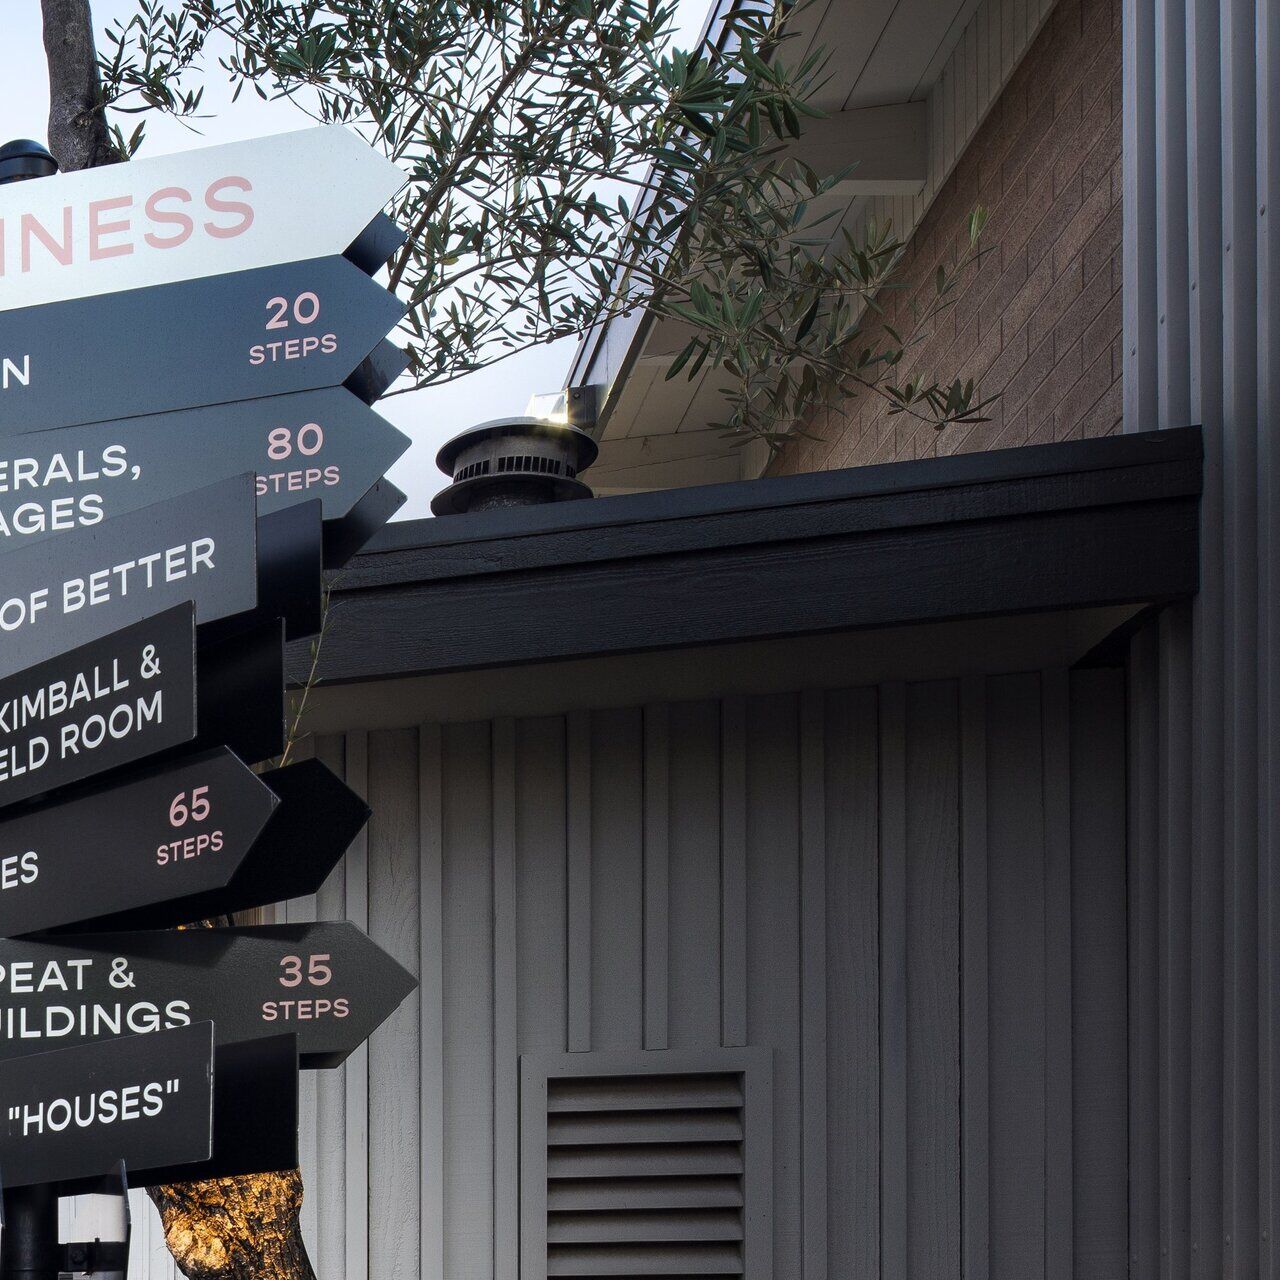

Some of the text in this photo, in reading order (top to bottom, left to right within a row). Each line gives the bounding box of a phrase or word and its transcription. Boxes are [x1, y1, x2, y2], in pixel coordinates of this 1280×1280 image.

[266, 292, 319, 329] 20
[250, 334, 337, 364] STEPS
[268, 423, 323, 459] 80
[256, 466, 339, 495] STEPS
[0, 588, 48, 630] OF
[64, 538, 214, 613] BETTER
[141, 645, 161, 678] &
[62, 690, 162, 758] ROOM
[170, 786, 210, 826] 65
[157, 831, 223, 865] STEPS
[109, 958, 135, 988] &
[280, 954, 331, 987] 35
[263, 999, 349, 1020] STEPS
[9, 1079, 179, 1135] "HOUSES"
